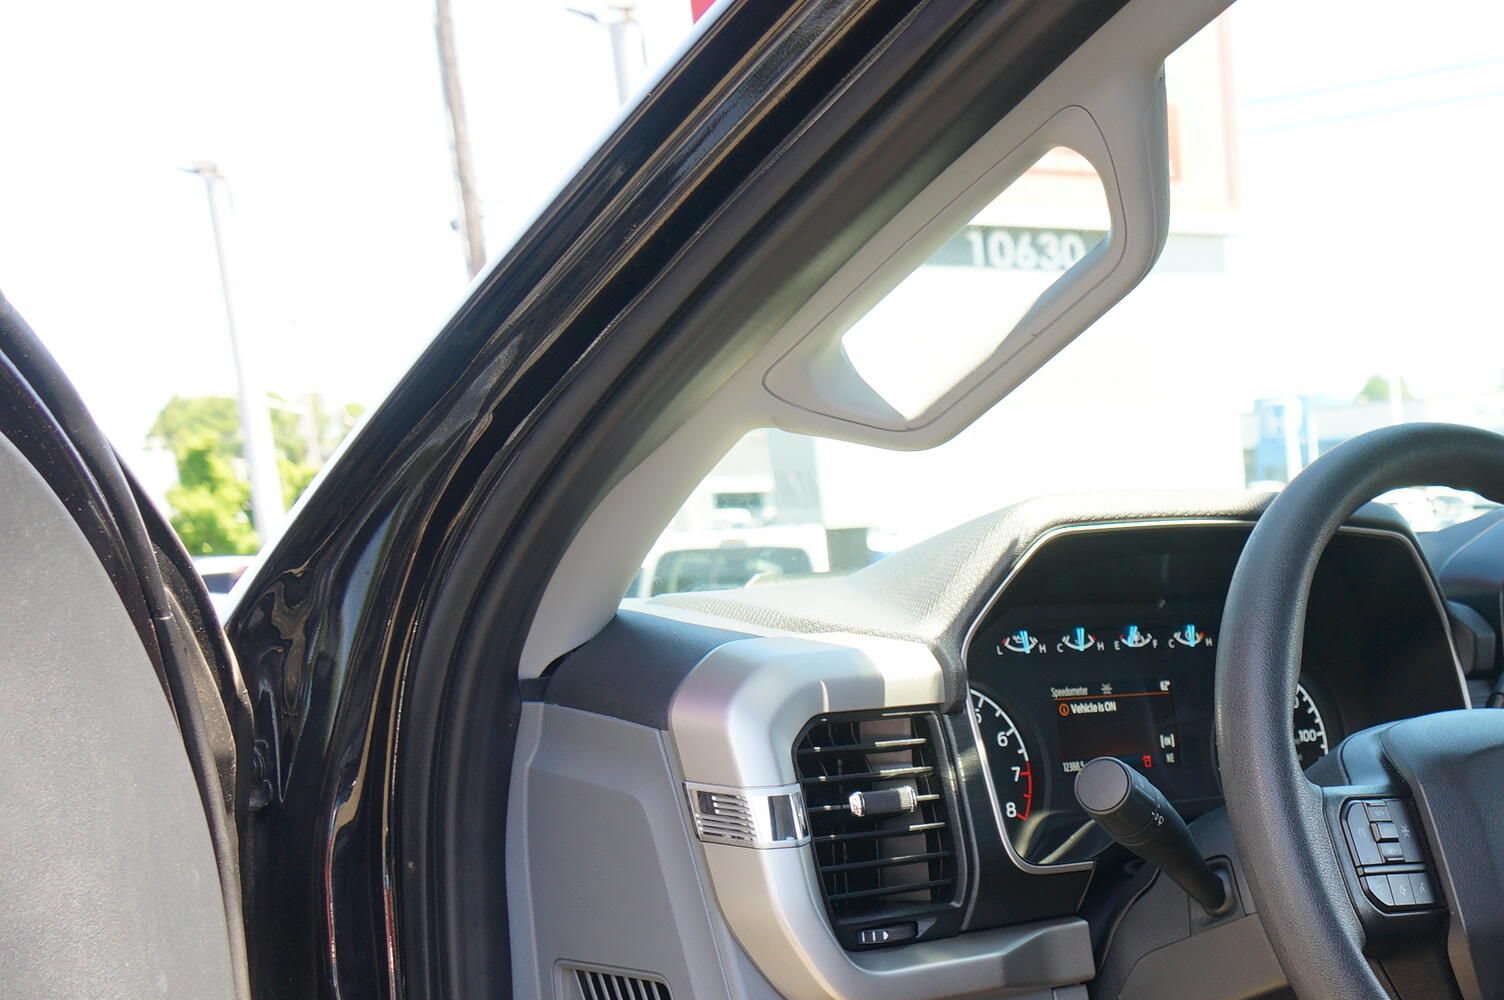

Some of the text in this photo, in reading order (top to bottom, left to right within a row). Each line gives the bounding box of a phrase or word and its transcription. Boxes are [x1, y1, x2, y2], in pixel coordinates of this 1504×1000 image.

[964, 229, 1086, 271] 10630
[996, 644, 1046, 655] L H
[1056, 642, 1104, 653] C H
[1114, 639, 1158, 651] E F
[1168, 637, 1213, 649] C H
[1050, 686, 1088, 699] Speedometer
[1070, 702, 1097, 714] Vehicle
[1105, 701, 1117, 712] ON
[997, 731, 1008, 747] 6
[1297, 729, 1317, 742] 100
[1011, 766, 1021, 782] 7
[1006, 801, 1017, 818] 8
